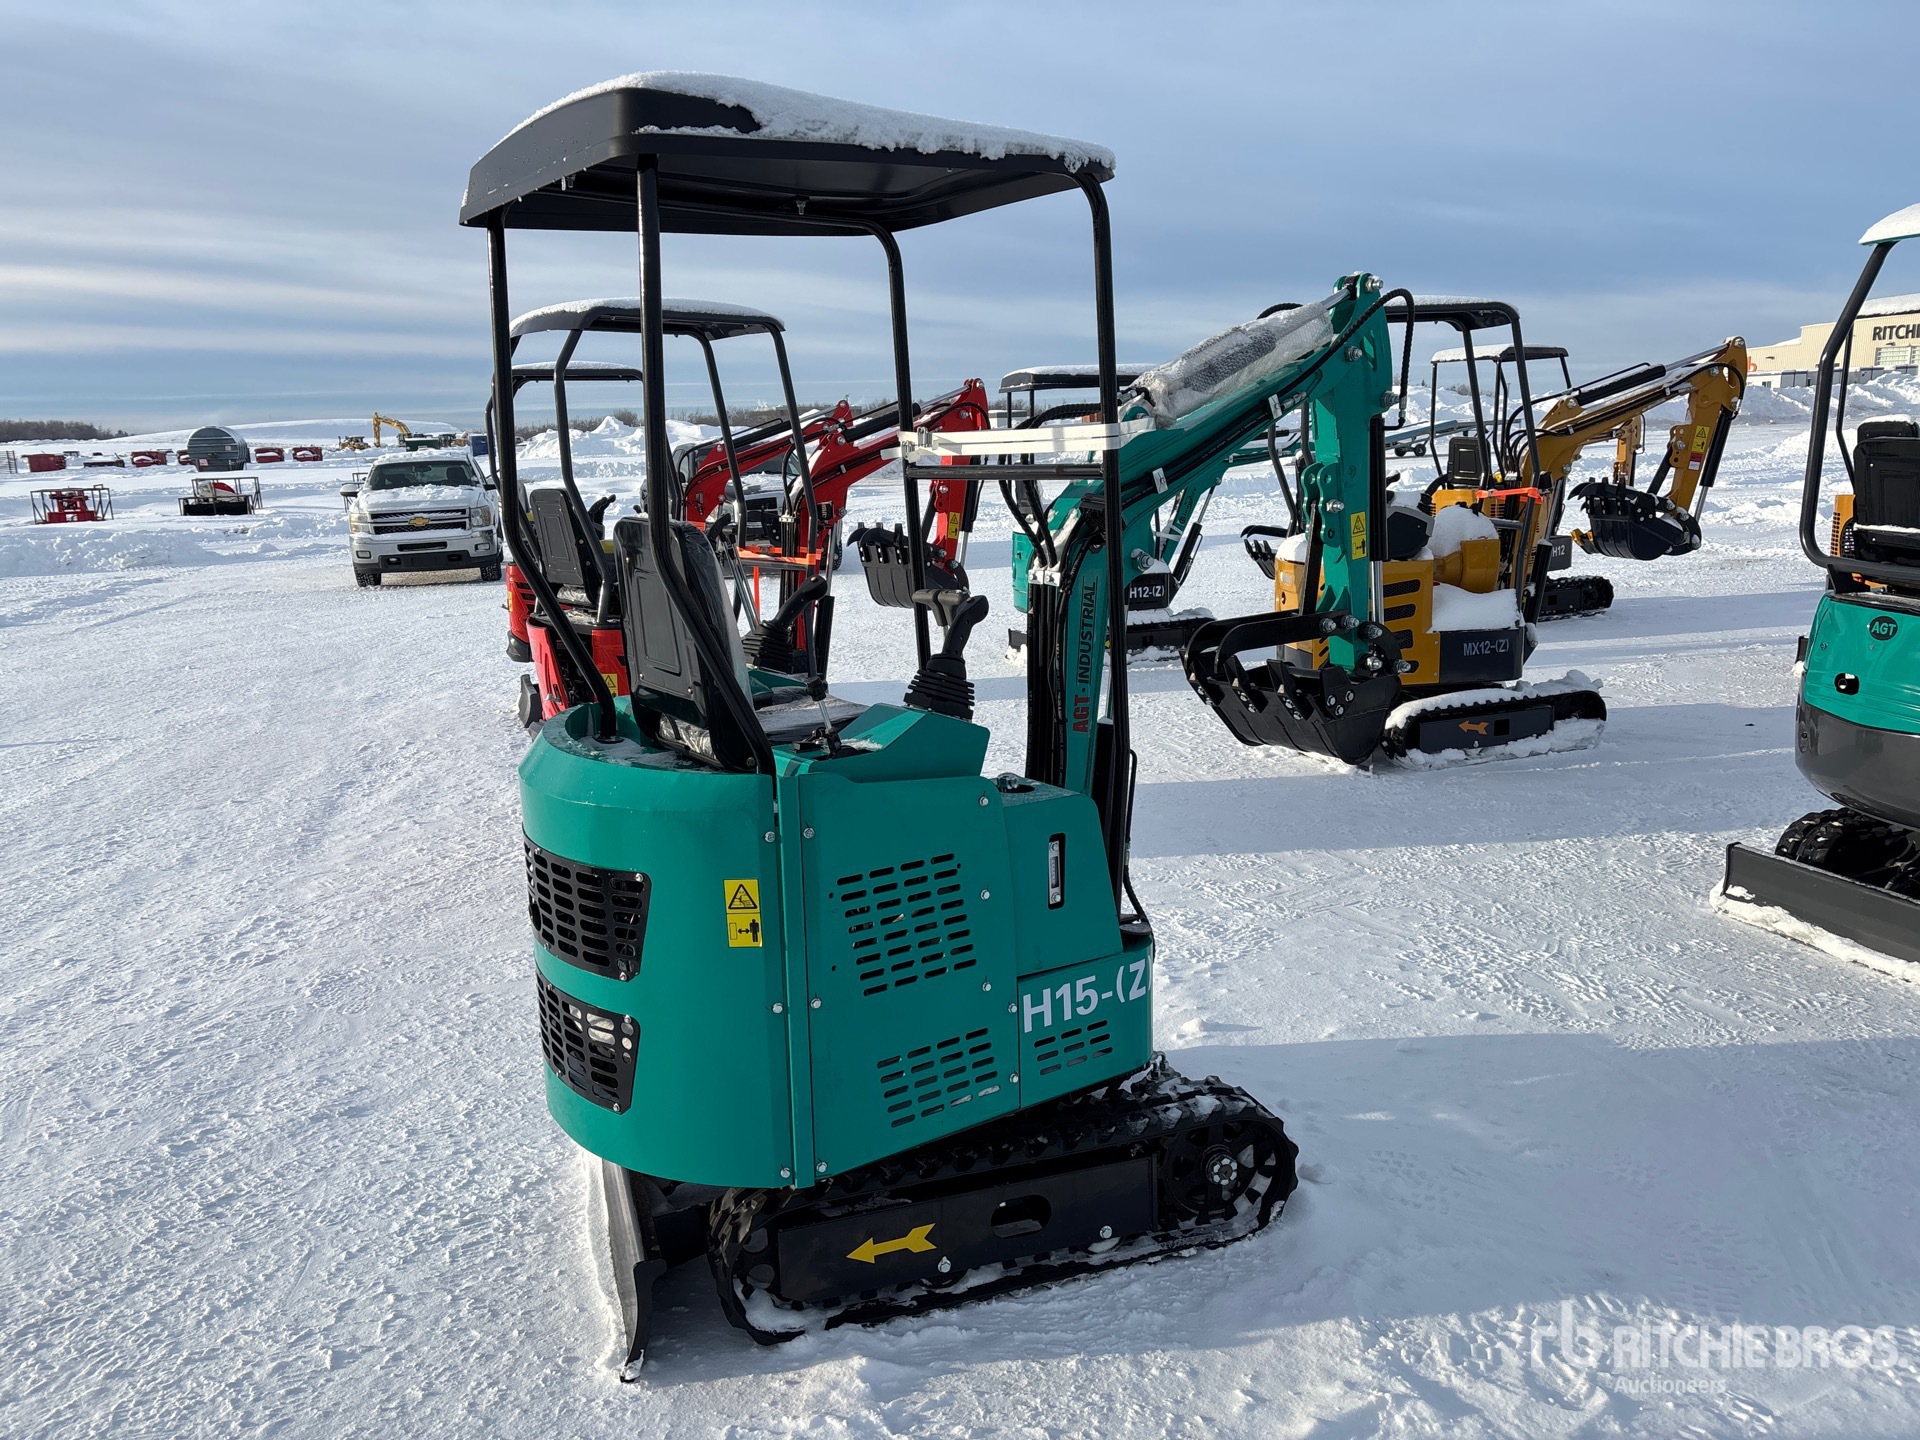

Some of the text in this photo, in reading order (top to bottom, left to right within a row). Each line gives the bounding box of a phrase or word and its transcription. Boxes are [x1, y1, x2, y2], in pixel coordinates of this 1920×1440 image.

[1129, 585, 1165, 599] H12-(Z)
[1077, 581, 1096, 685] INDUSTRIAL
[1871, 621, 1897, 636] AGT
[1463, 639, 1510, 656] MX12-(Z)
[1072, 694, 1090, 733] AGT
